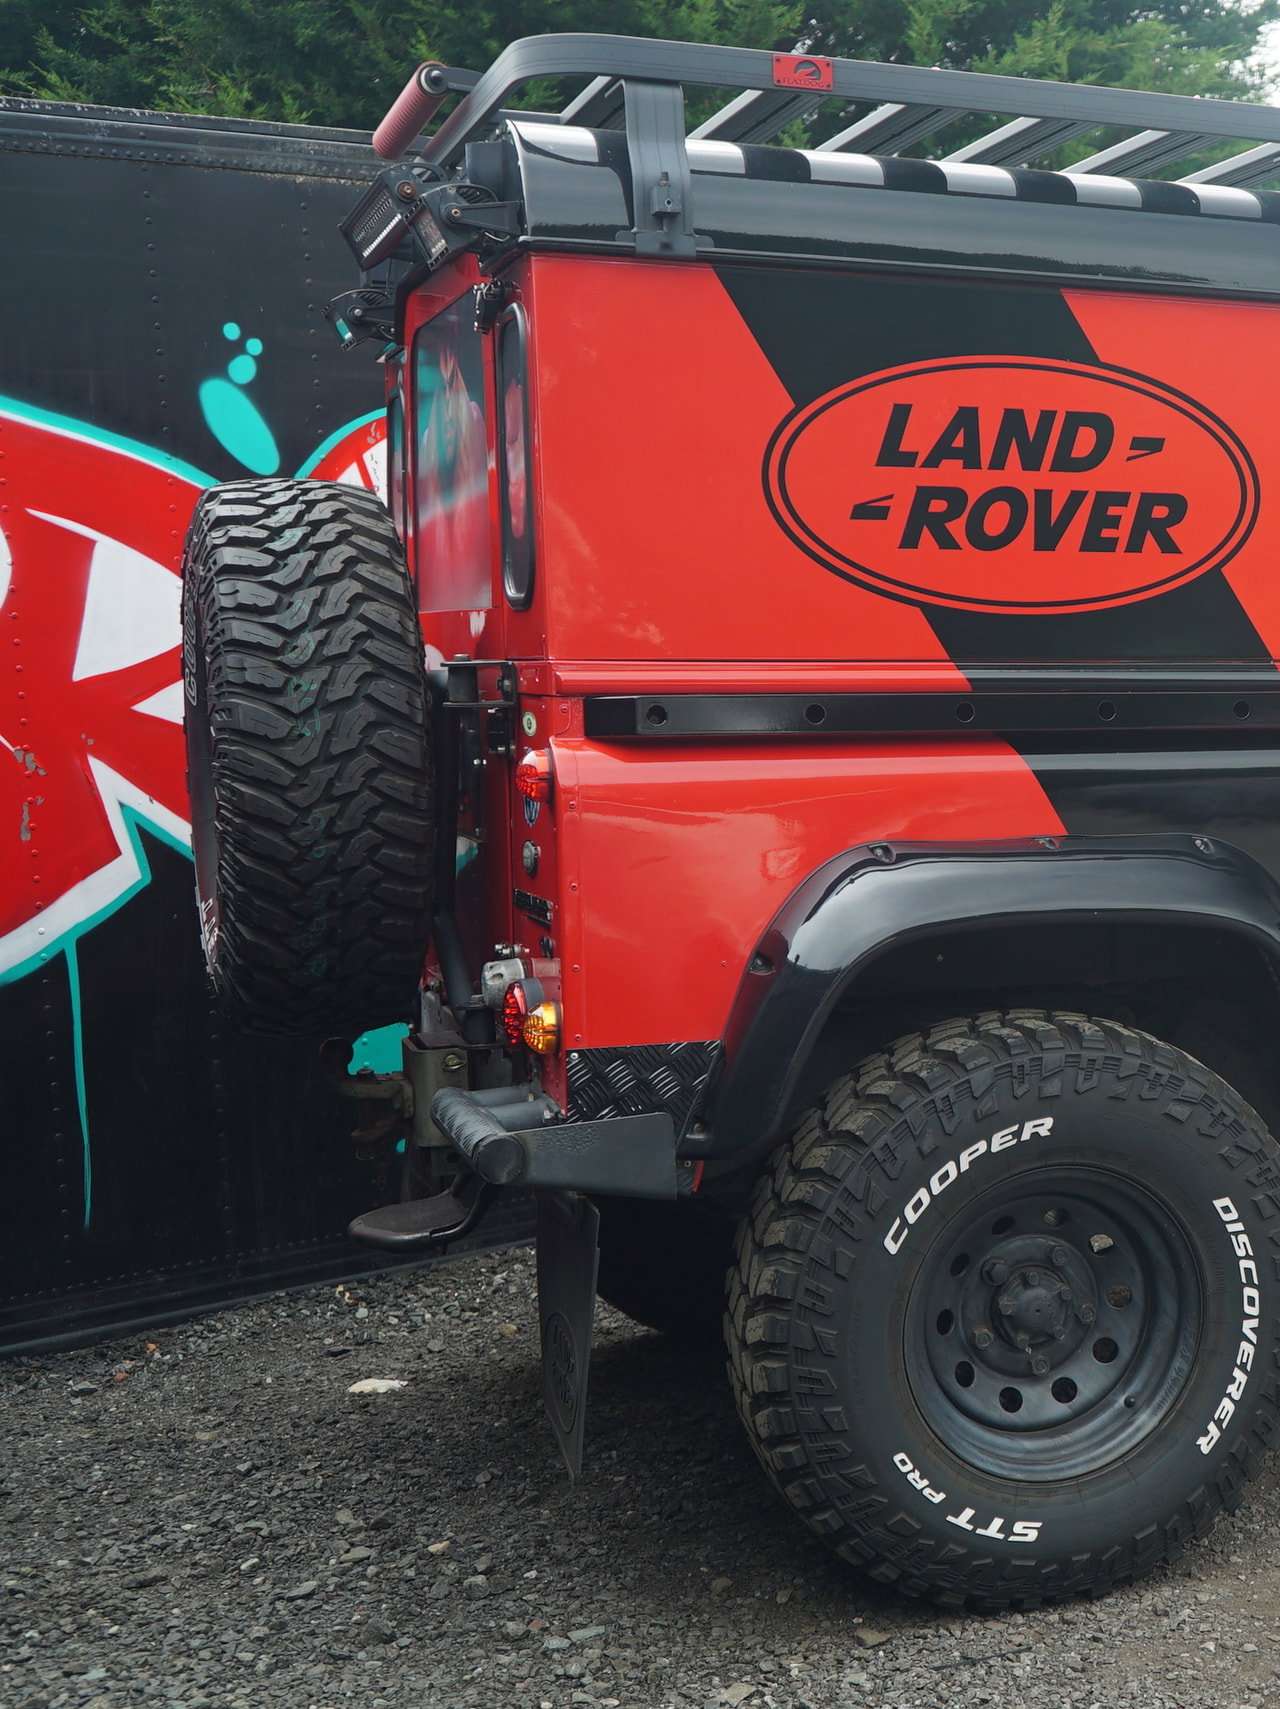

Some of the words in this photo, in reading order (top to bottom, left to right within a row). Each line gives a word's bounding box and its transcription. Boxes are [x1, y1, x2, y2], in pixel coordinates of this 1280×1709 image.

[874, 403, 1115, 474] LAND
[897, 485, 1189, 555] ROVER
[883, 1116, 1054, 1255] COOPER
[1195, 1196, 1260, 1455] DISCOVERER
[892, 1452, 947, 1504] PRO
[945, 1506, 1043, 1543] STT
